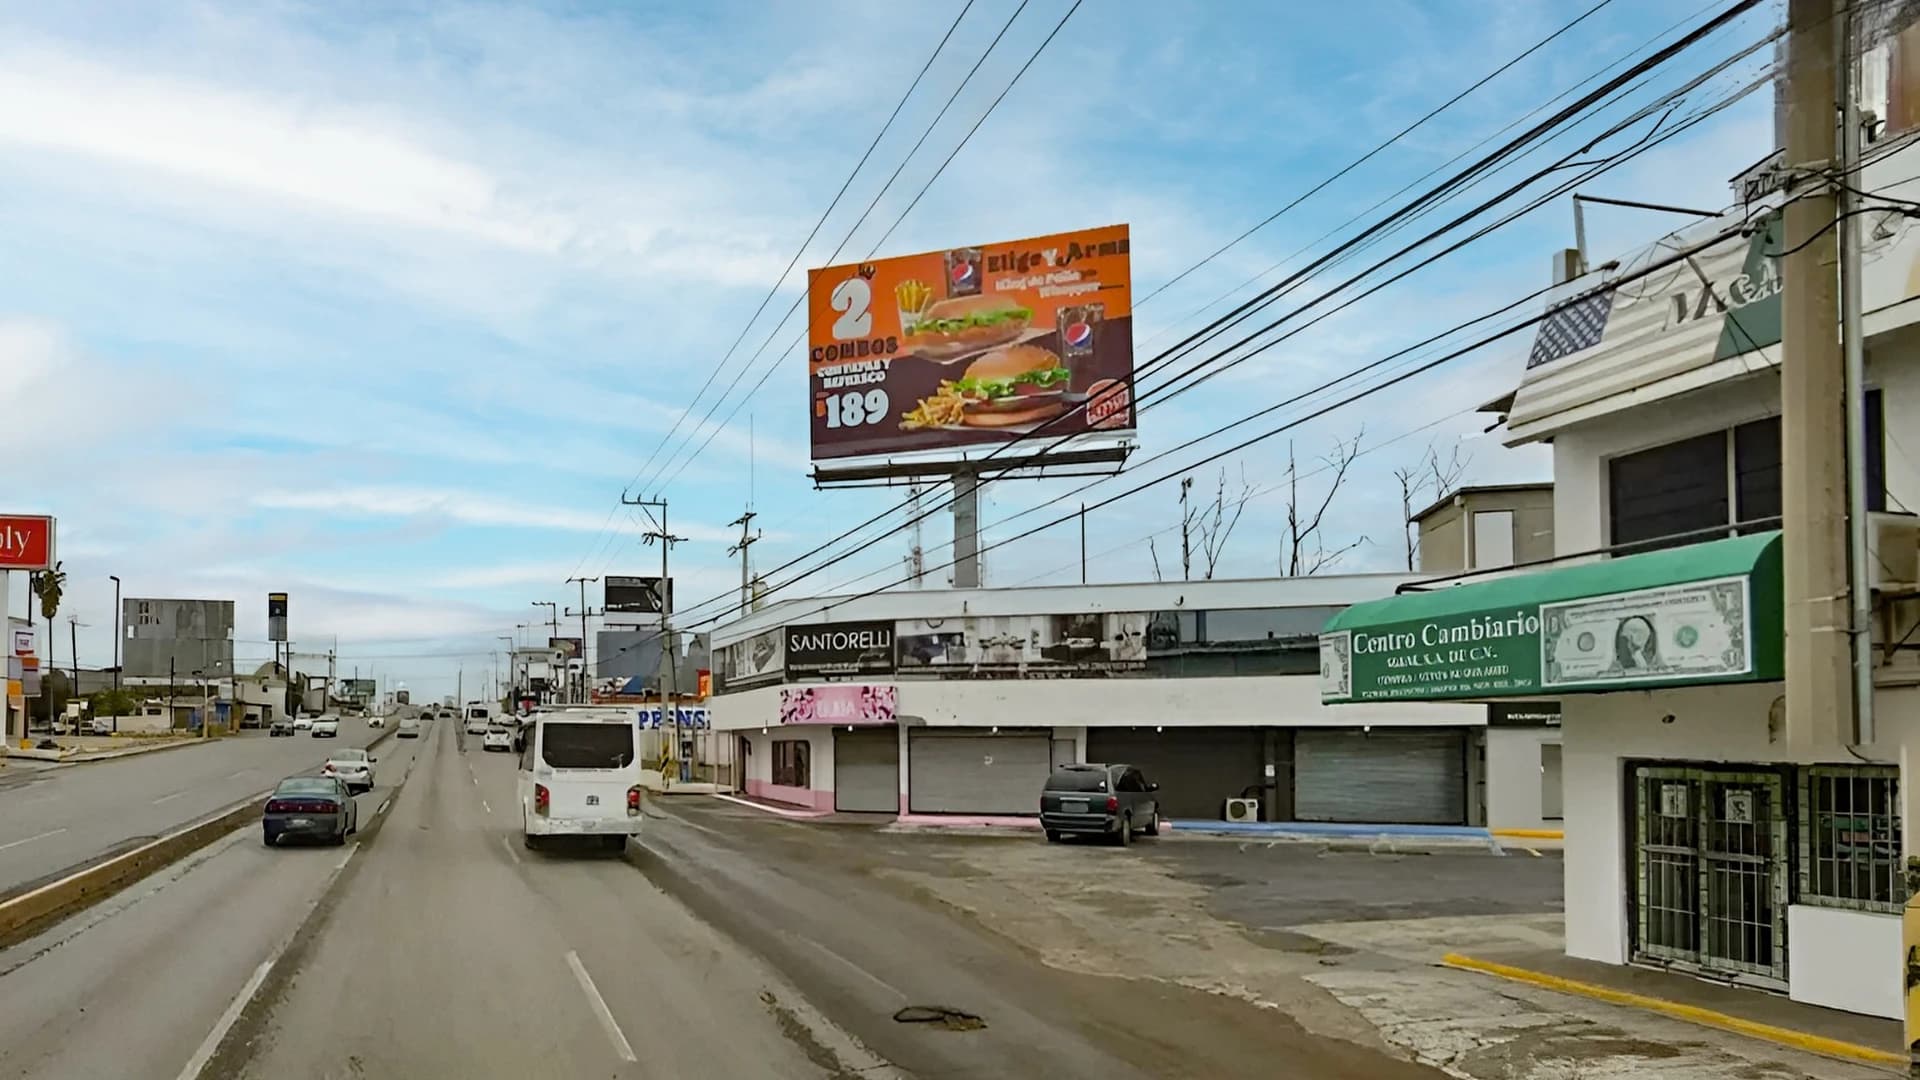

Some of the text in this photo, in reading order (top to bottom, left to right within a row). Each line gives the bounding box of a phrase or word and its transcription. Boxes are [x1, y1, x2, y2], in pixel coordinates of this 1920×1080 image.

[831, 278, 872, 339] 2
[812, 336, 898, 362] COMBOS
[825, 388, 889, 429] 189
[790, 629, 890, 652] SANTORELLI
[1353, 611, 1540, 654] Centro Cambiario
